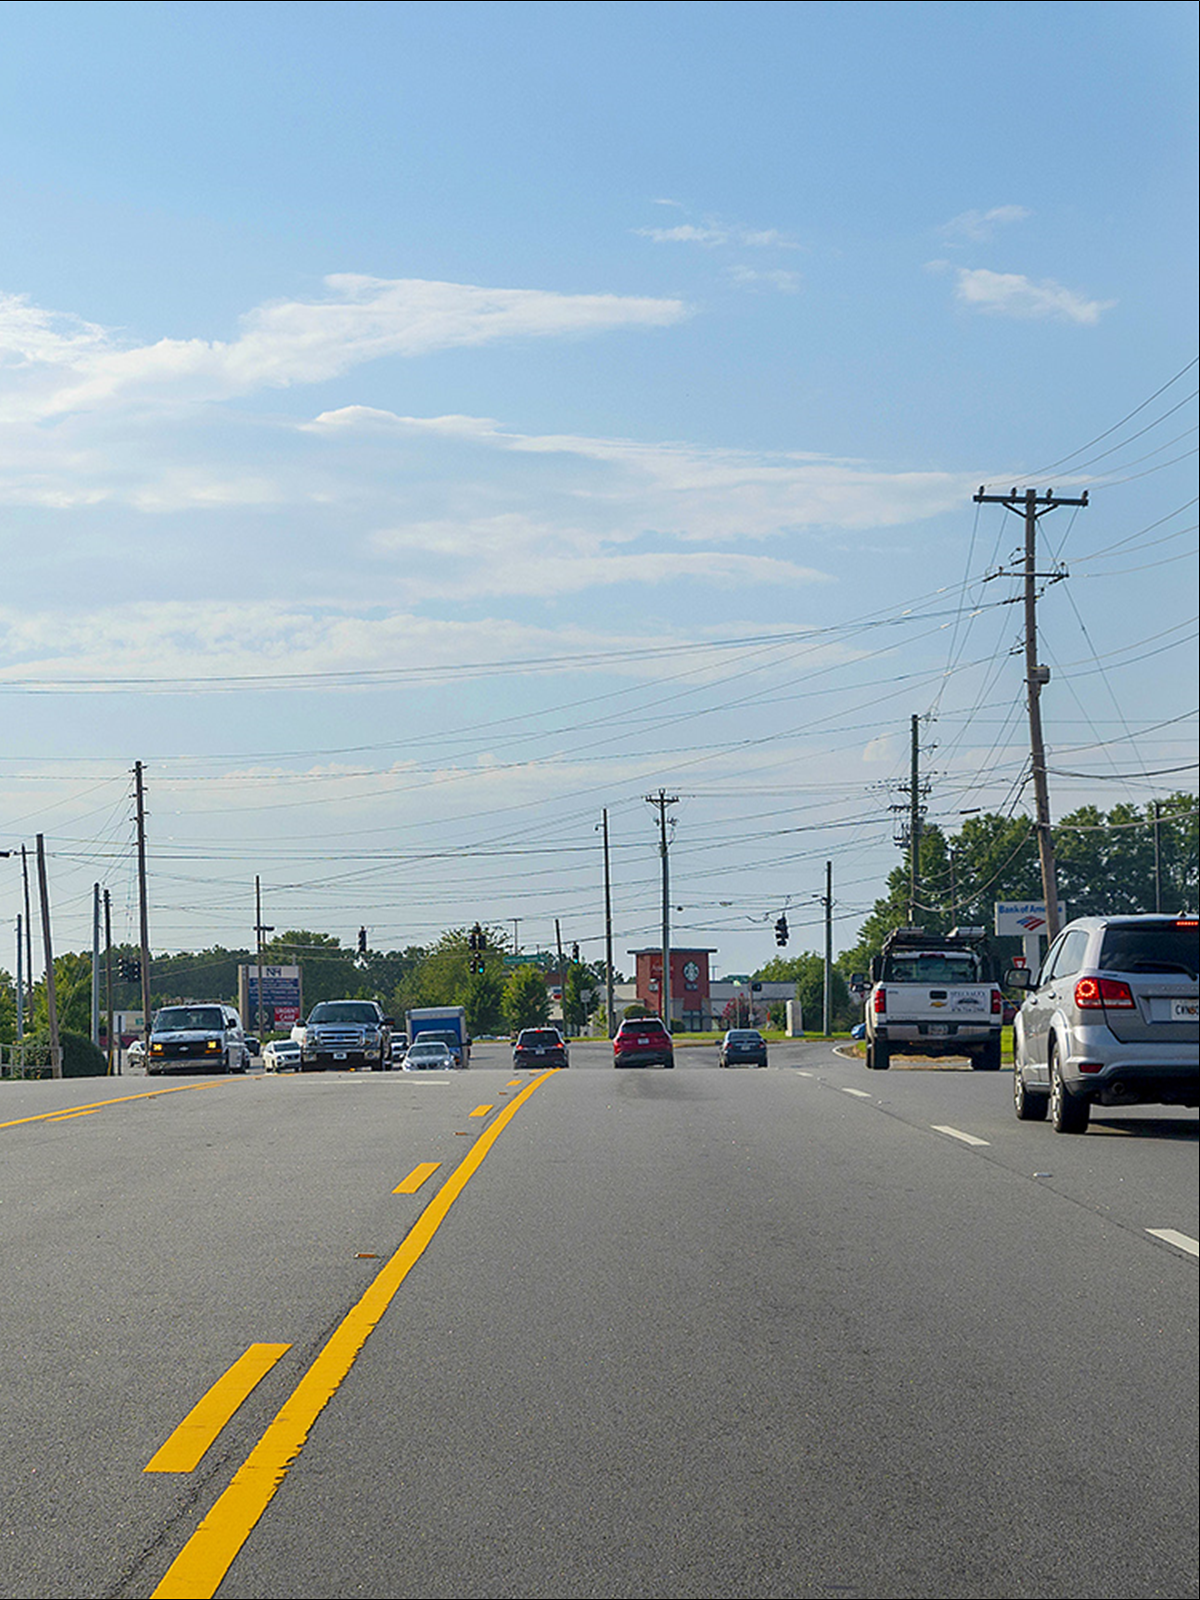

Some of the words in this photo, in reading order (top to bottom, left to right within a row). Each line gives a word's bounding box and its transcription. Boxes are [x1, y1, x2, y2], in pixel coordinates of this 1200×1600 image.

[998, 905, 1019, 914] Bank
[1020, 905, 1029, 914] of
[266, 967, 282, 977] NH
